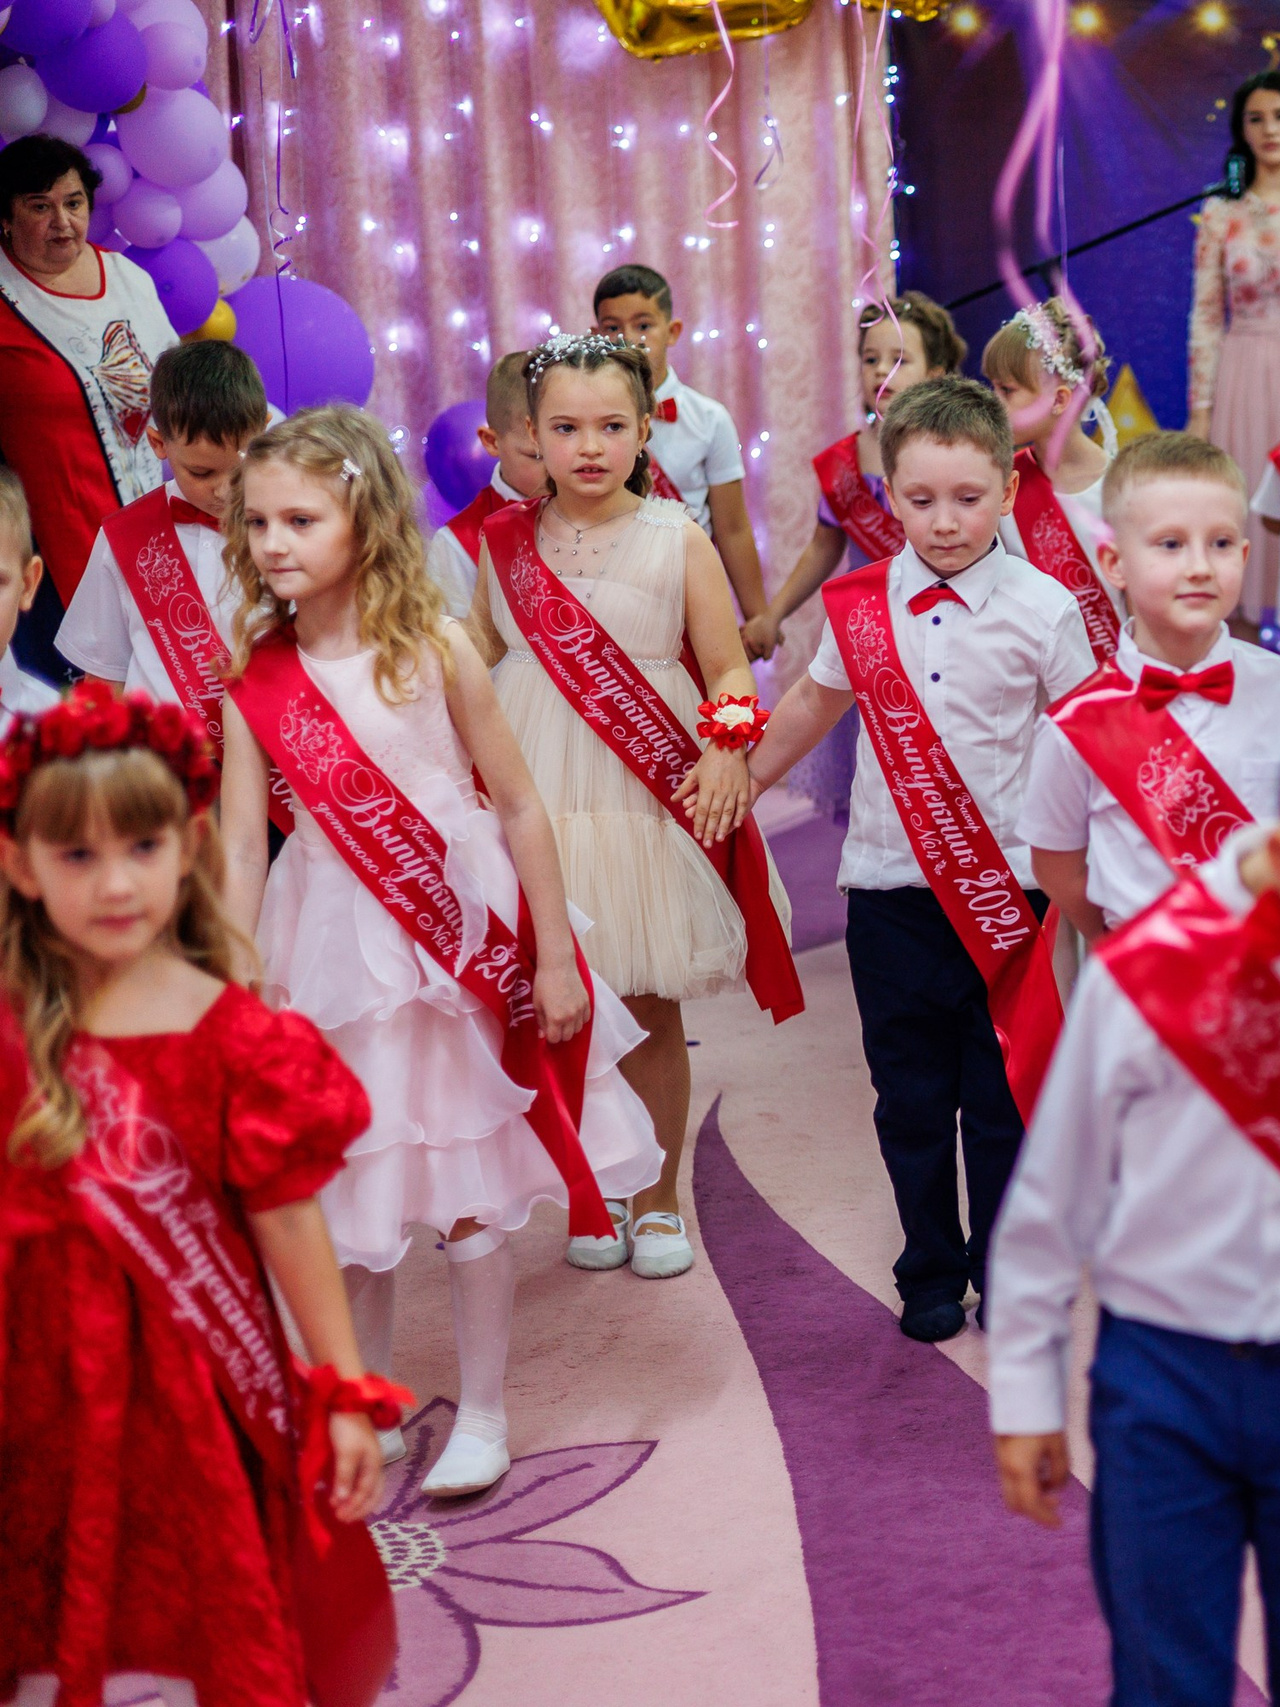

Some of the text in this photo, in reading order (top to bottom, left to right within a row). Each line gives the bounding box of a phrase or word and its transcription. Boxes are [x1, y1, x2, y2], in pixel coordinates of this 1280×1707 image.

[147, 617, 207, 719] детского сада
[528, 632, 649, 764] детского сада №4
[539, 596, 682, 770] Выпускница
[635, 655, 686, 748] Александра
[856, 690, 938, 860] детского сада №4
[873, 666, 978, 868] Выпускник
[954, 868, 1030, 951] 2024
[927, 742, 981, 835] Саидов Захар
[311, 801, 453, 956] детского сада №4
